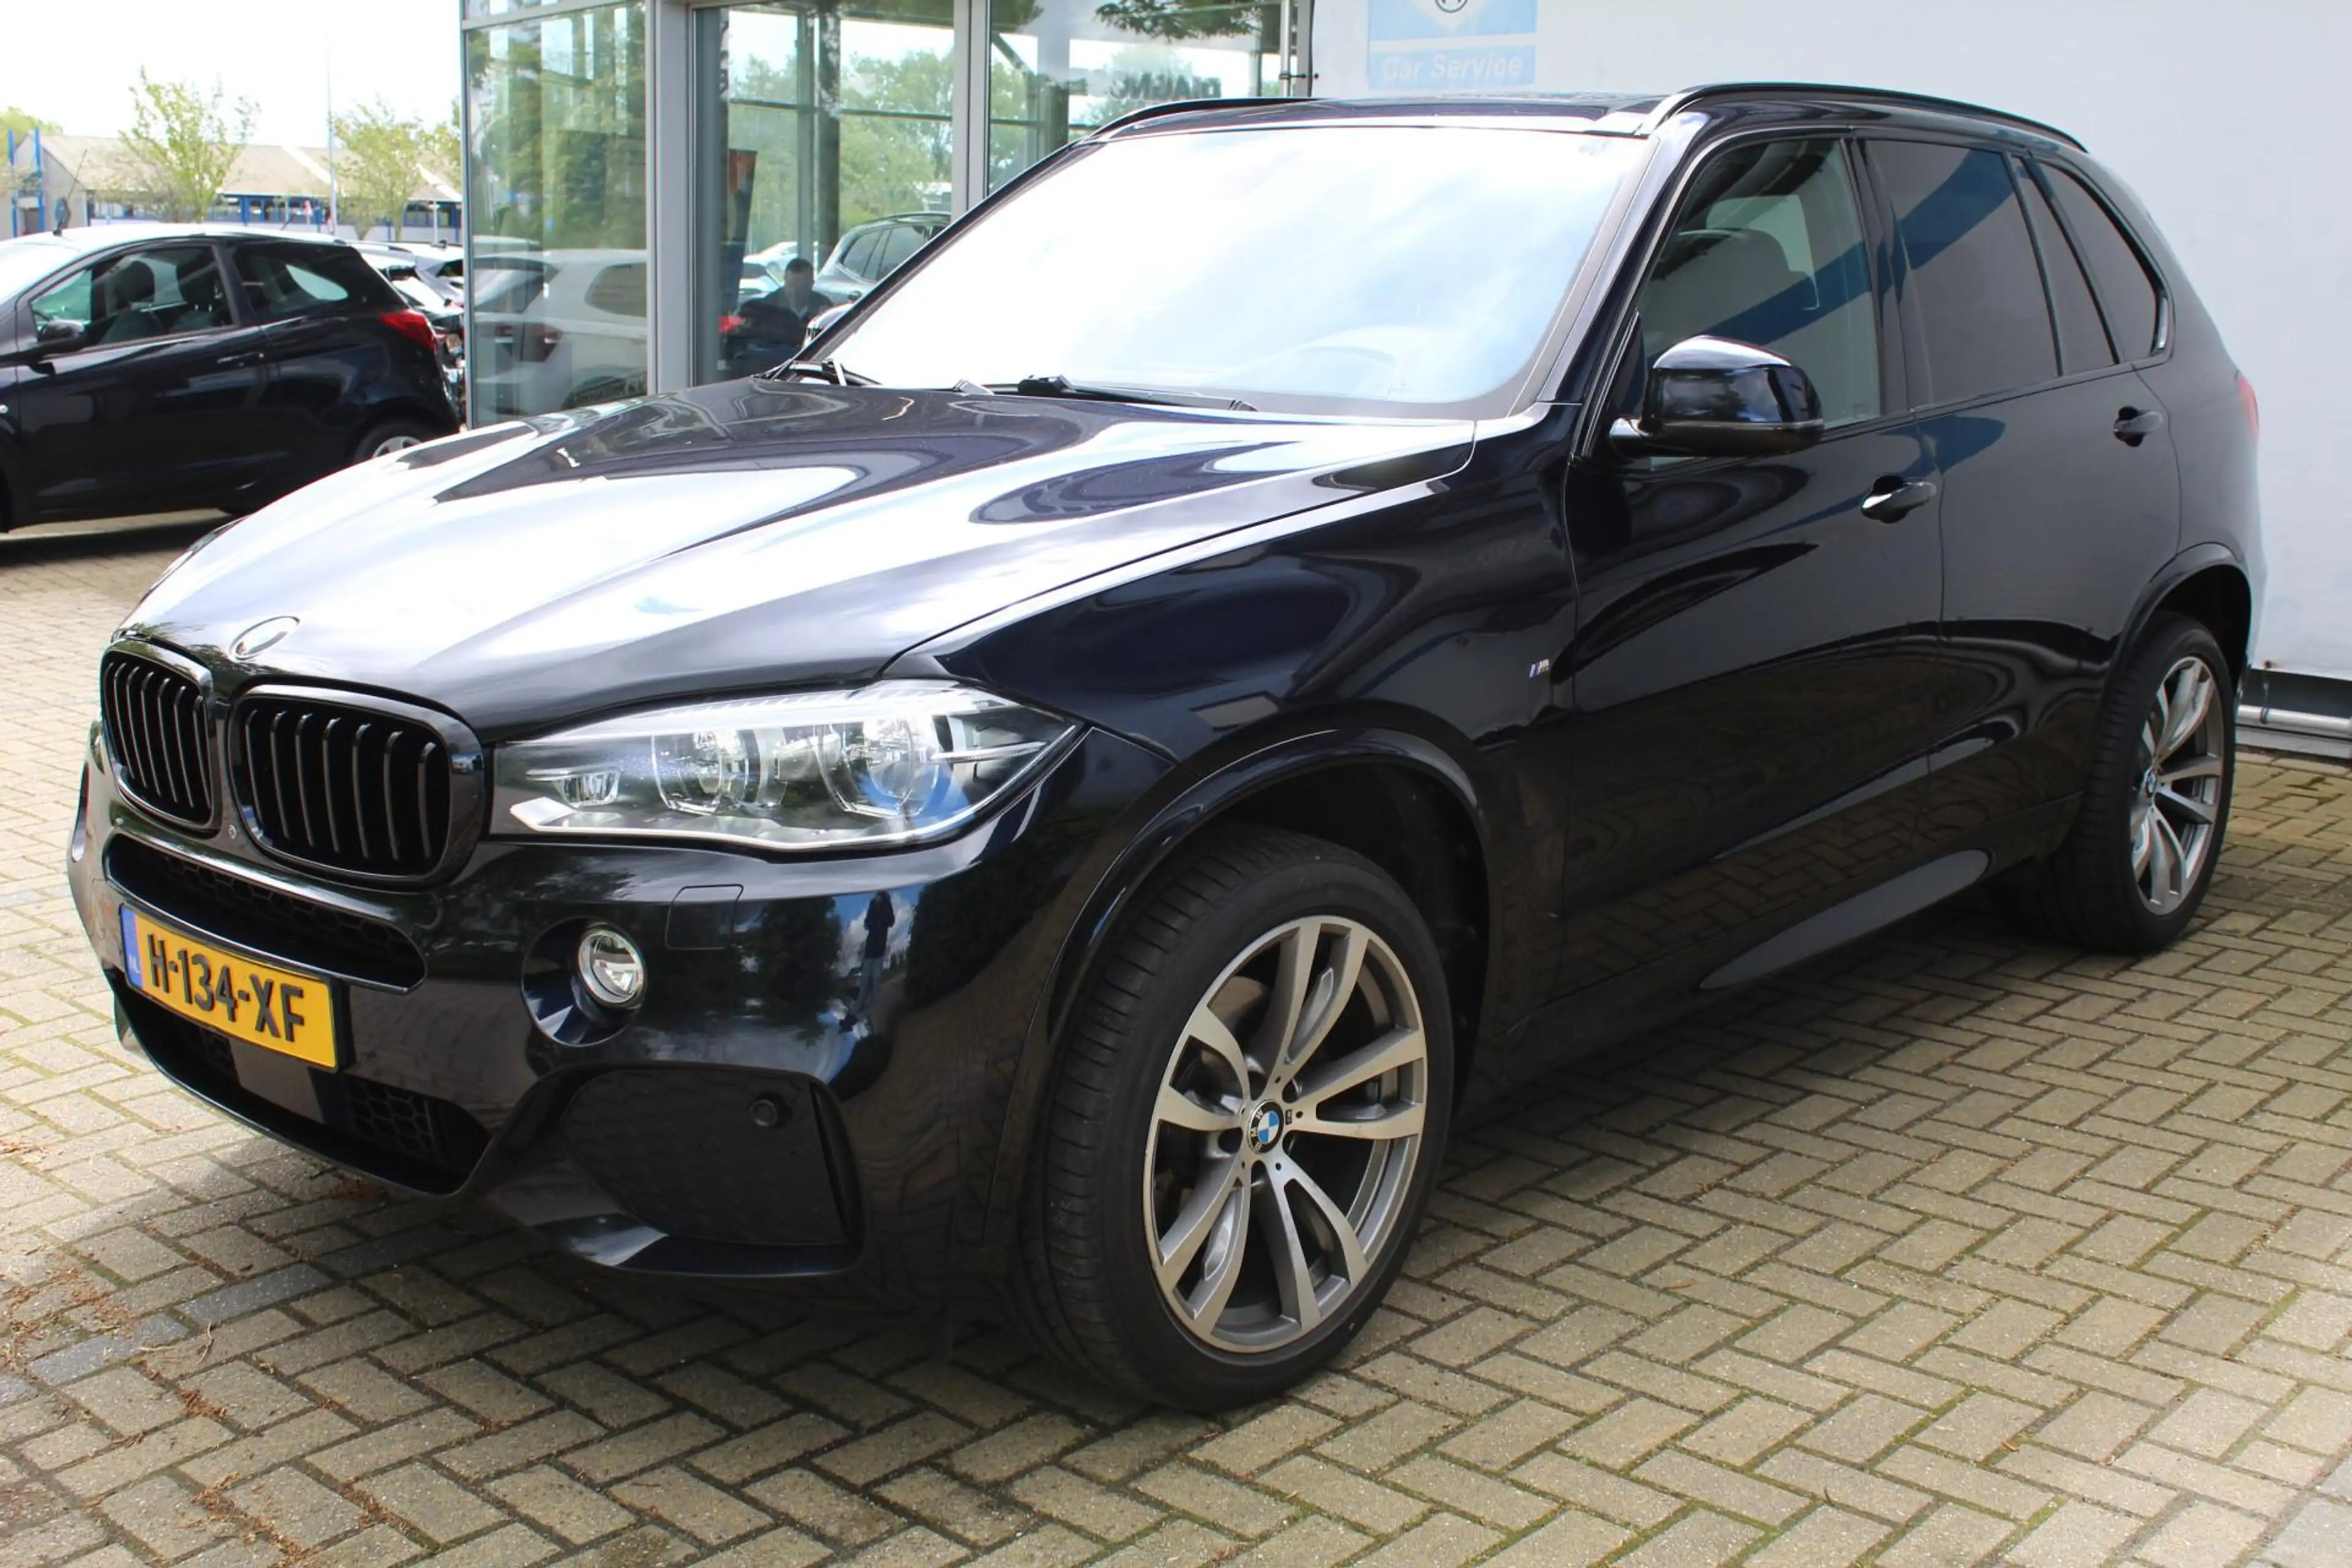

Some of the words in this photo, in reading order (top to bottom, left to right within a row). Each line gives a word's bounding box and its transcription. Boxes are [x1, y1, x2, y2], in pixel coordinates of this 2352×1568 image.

[1382, 56, 1425, 81] Car
[1431, 52, 1523, 80] Service
[147, 933, 305, 1042] H-134-XF
